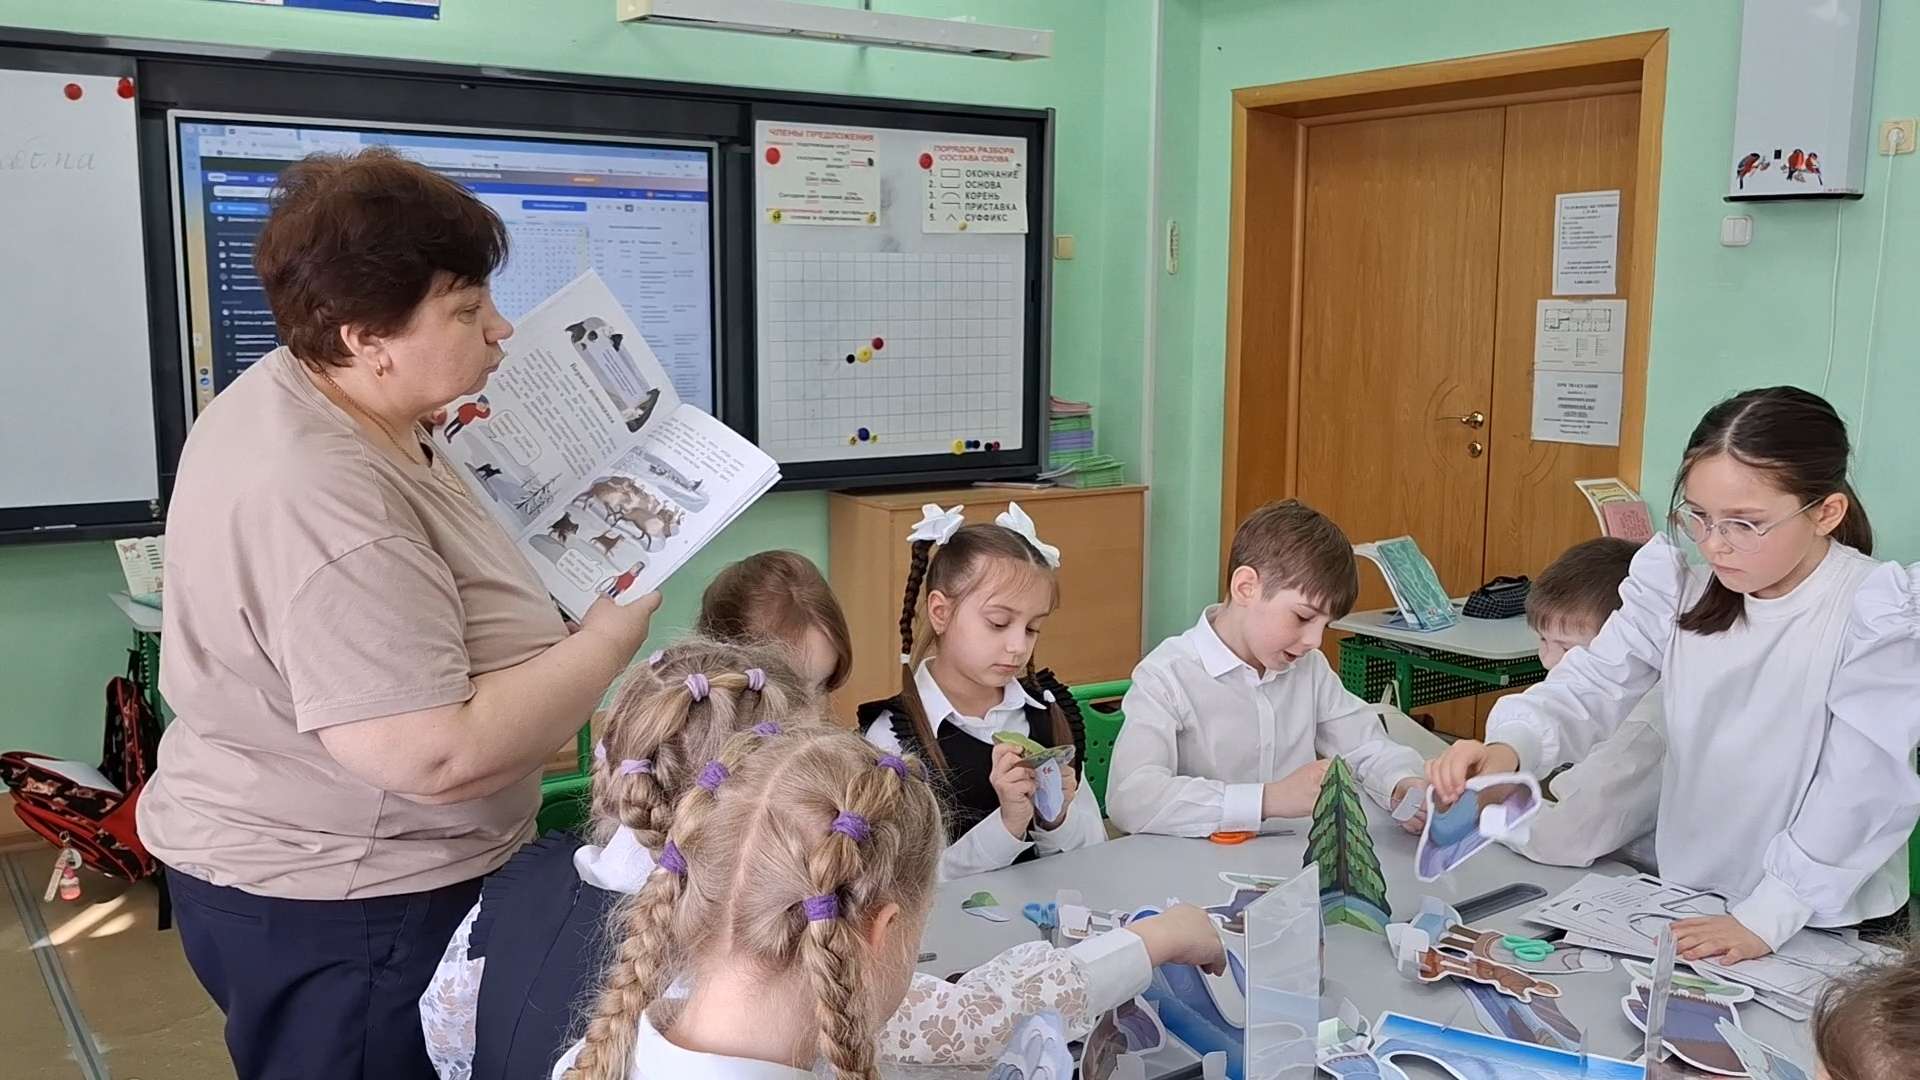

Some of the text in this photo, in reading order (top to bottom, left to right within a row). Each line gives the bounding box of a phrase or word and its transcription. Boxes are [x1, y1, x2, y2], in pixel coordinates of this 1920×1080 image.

[768, 128, 874, 142] ЧЛЕНЫ ПРЕДЛОЖЕНИЯ
[933, 145, 1015, 154] ПОРЯДОК РАЗБОРА
[939, 154, 1009, 163] СОСТАВА СЛОВА
[965, 169, 1020, 179] ОКОНЧАНИЕ
[965, 181, 1002, 189] ОСНОВА
[965, 192, 1001, 200] КОРЕНЬ
[965, 202, 1018, 211] ПРИСТАВКА
[964, 213, 1009, 222] СУФФИКС
